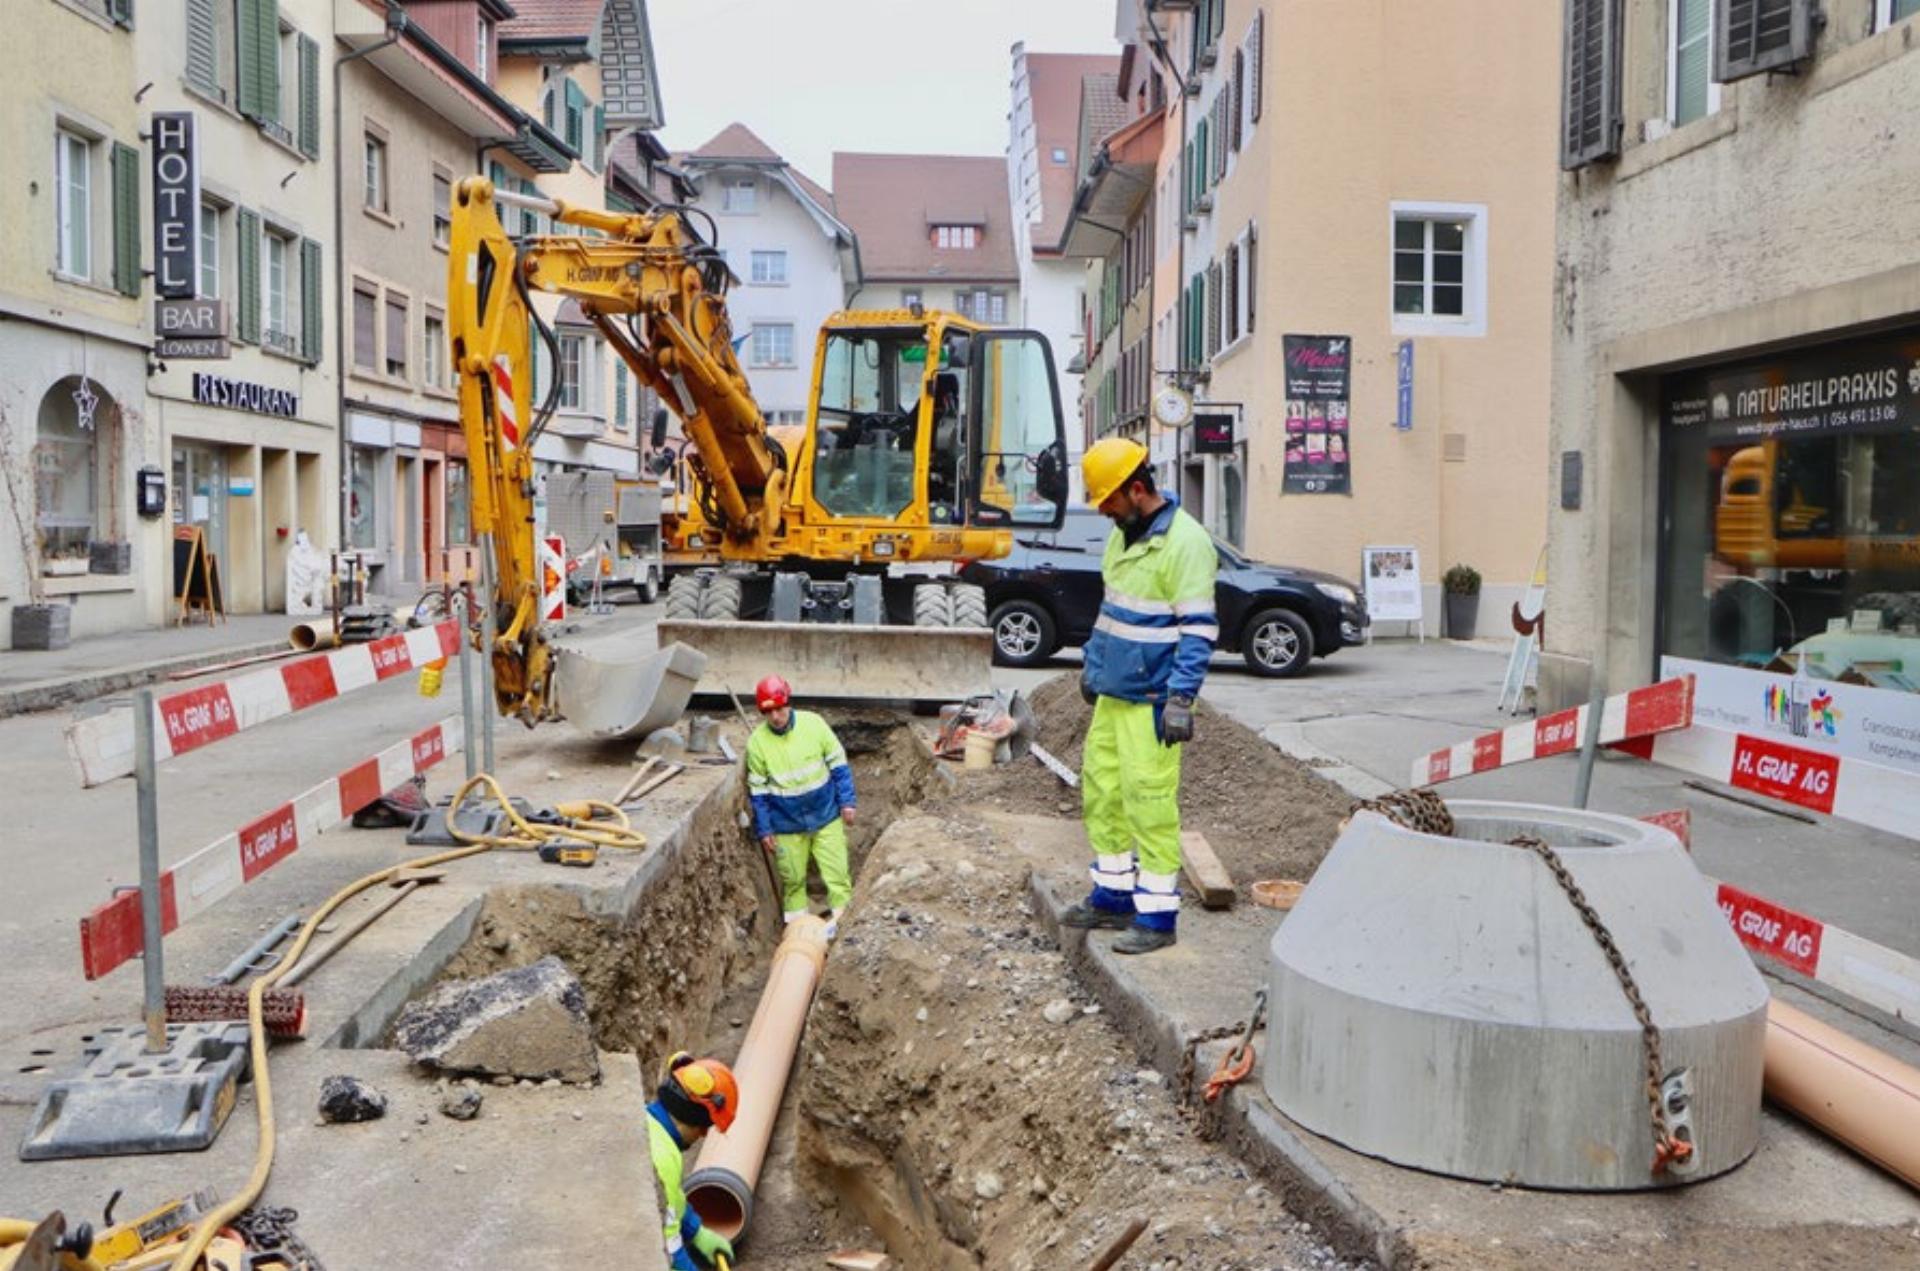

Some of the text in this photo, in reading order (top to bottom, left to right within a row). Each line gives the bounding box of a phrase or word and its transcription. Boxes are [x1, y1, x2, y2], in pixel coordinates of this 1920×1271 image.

[158, 119, 188, 286] HOTEL
[162, 307, 215, 329] BAR
[194, 371, 301, 417] RESTAURANT
[1736, 368, 1898, 417] NATURHEILPRAXIS
[1830, 410, 1848, 426] 056
[1849, 408, 1866, 424] 491
[1869, 406, 1881, 422] 13
[1883, 404, 1898, 420] 06
[169, 697, 231, 738] H. GRAF AG
[1737, 750, 1829, 795] H. GRAF AG
[244, 819, 293, 865] H. GRAF AG
[1739, 910, 1782, 943] GRAF
[1783, 929, 1812, 958] AG
